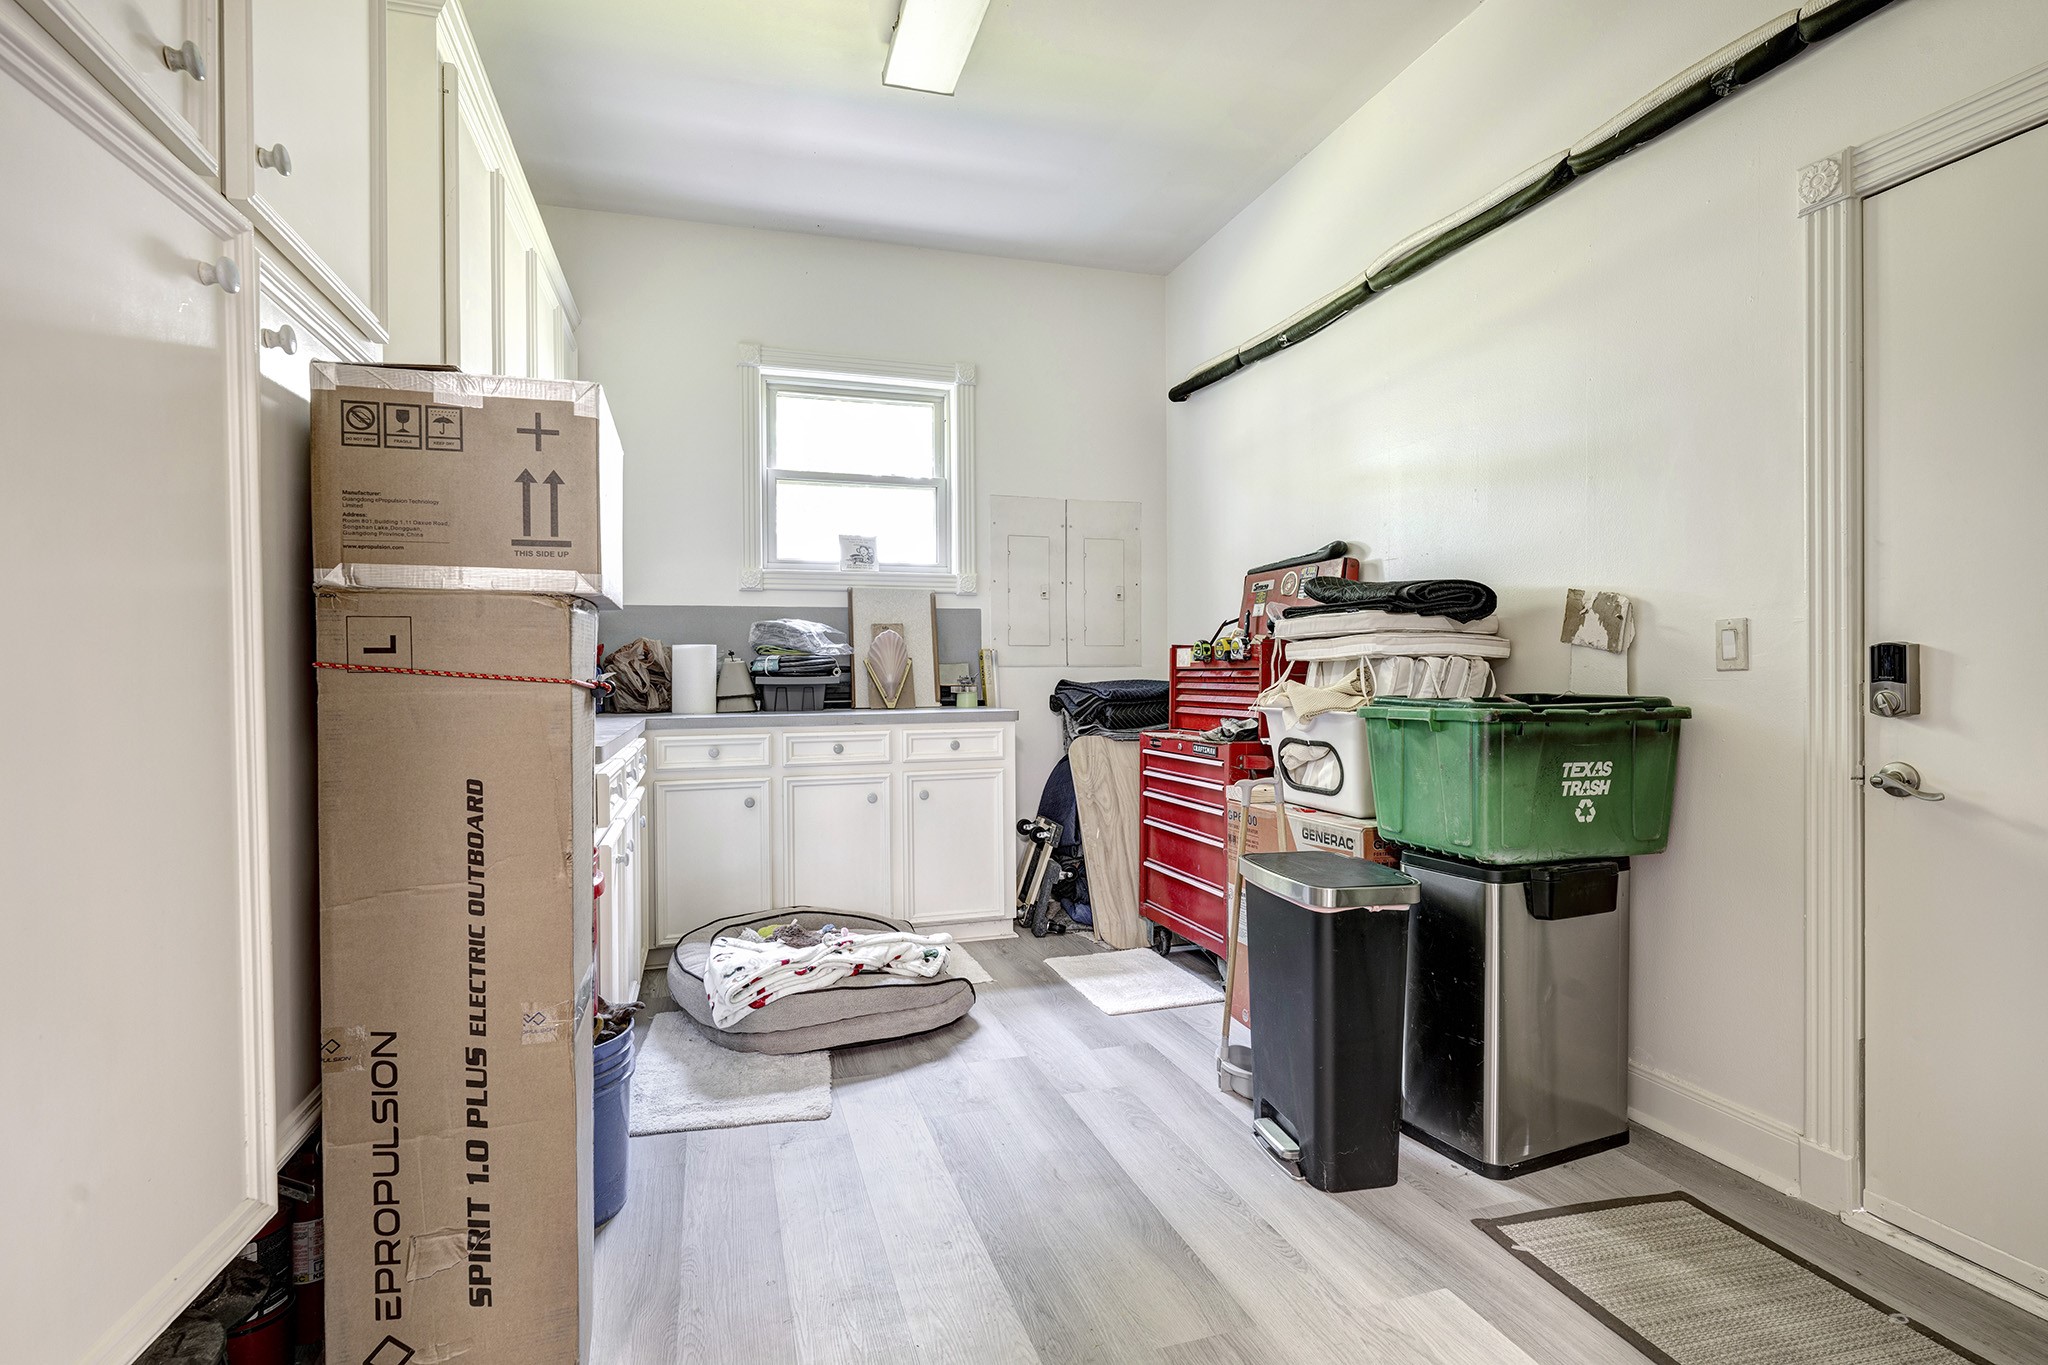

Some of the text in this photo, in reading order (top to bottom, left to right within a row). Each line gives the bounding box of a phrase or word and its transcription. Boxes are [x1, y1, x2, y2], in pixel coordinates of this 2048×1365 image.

[1562, 761, 1613, 778] TEXAS
[1561, 780, 1612, 797] TRASH
[1301, 827, 1355, 850] GENERAC
[465, 778, 493, 1308] SPIRIT 1.0 PLUS ELECTRIC OUTBOARD
[370, 1032, 402, 1321] EPROPULSION
